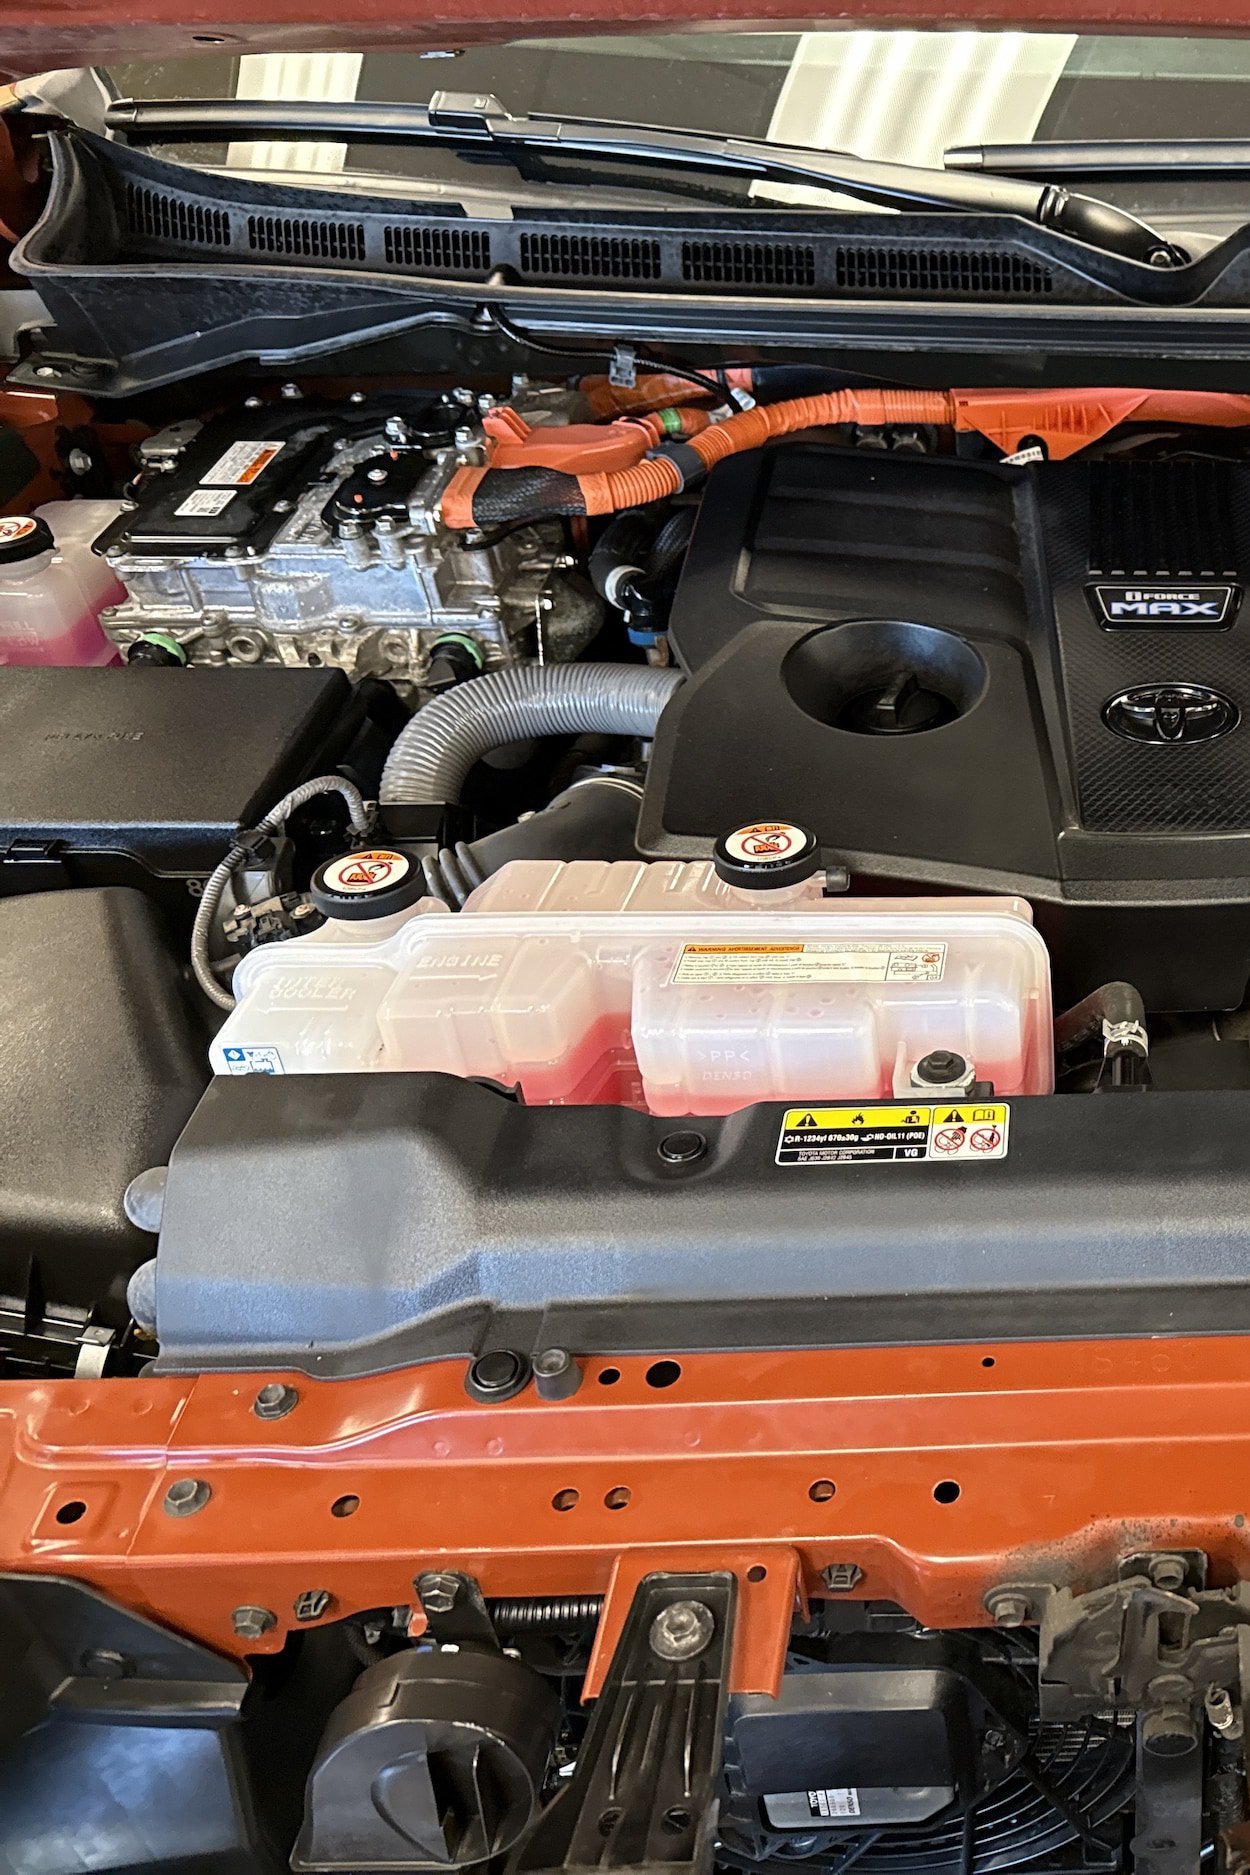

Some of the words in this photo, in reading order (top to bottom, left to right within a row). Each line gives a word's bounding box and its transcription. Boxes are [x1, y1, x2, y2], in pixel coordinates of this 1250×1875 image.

[1110, 602, 1218, 616] MAX
[417, 954, 503, 968] ENGINE
[702, 1071, 752, 1081] DENSO
[904, 1149, 918, 1157] VG
